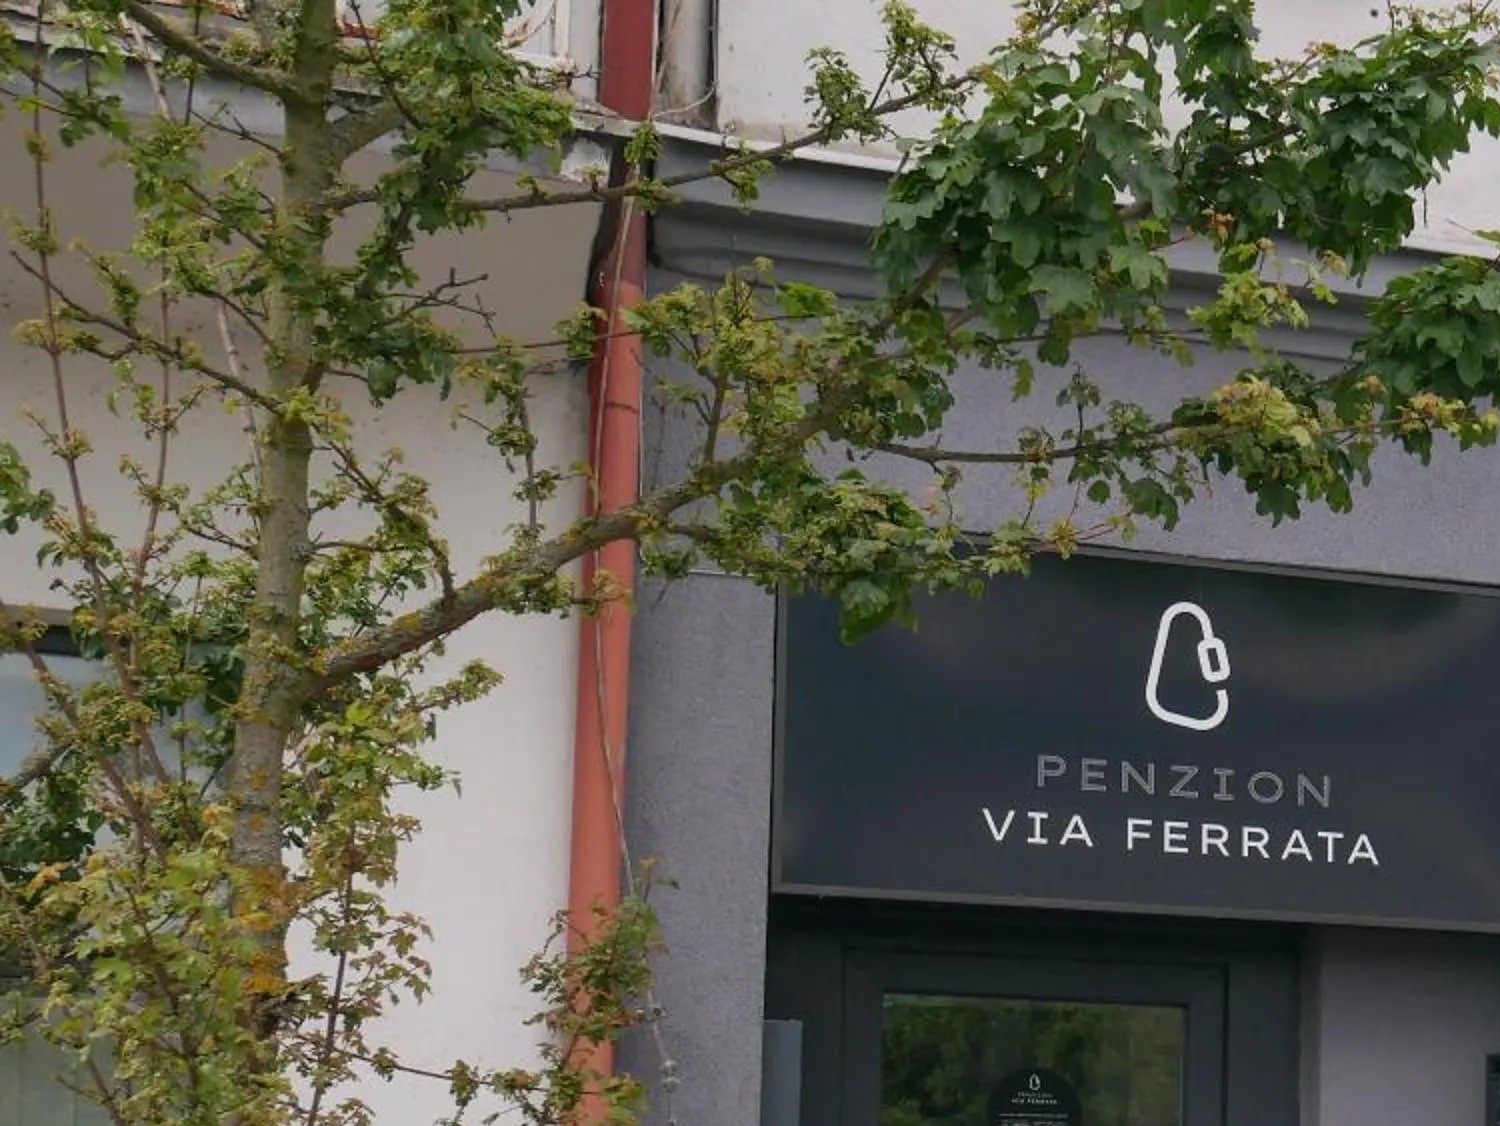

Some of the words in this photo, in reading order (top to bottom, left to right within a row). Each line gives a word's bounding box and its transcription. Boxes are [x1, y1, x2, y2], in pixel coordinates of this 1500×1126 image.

[1035, 754, 1331, 808] PENZION
[982, 808, 1093, 847] VIA
[1126, 818, 1380, 866] FERRATA
